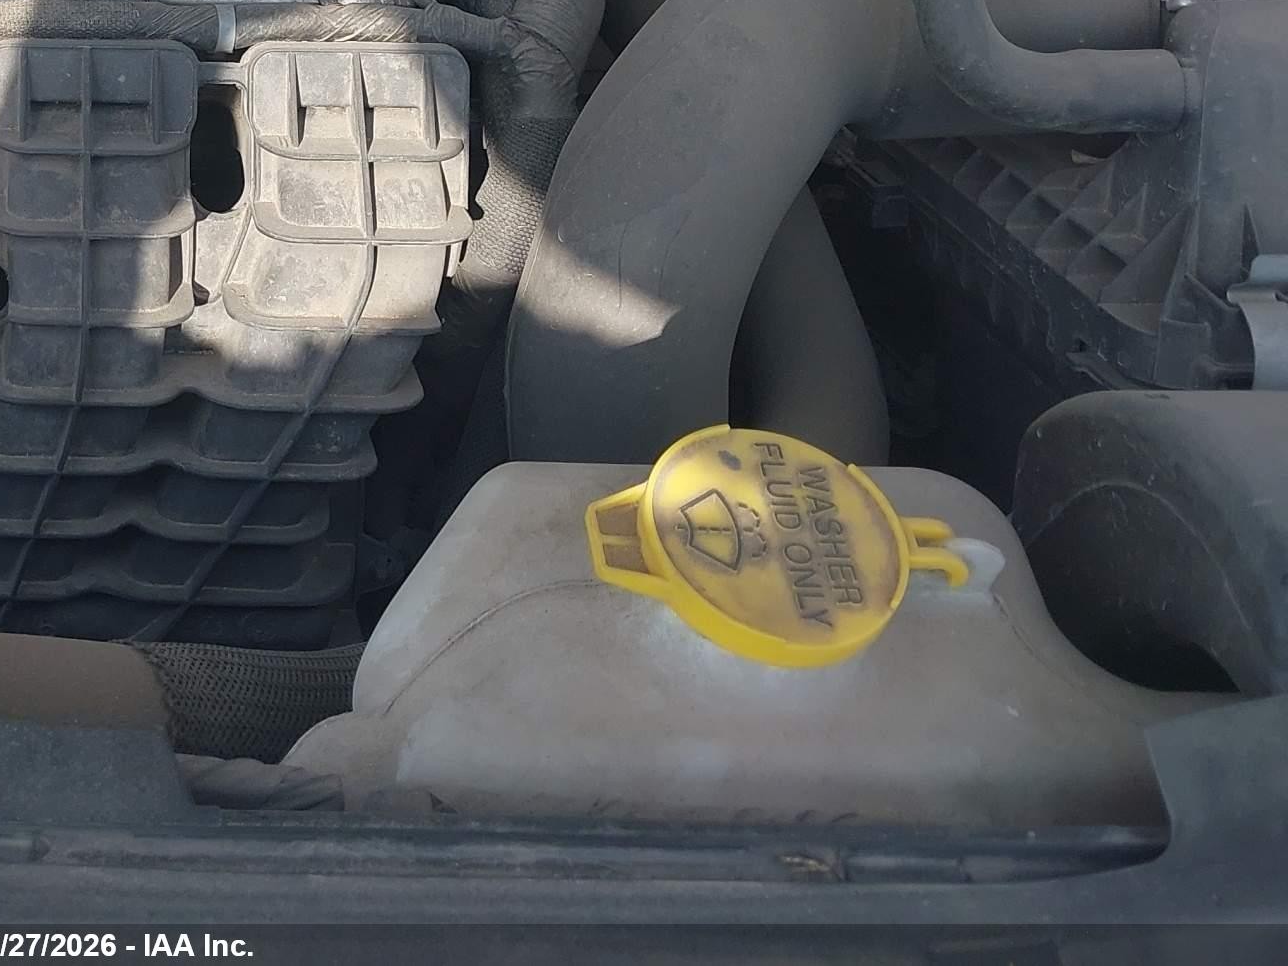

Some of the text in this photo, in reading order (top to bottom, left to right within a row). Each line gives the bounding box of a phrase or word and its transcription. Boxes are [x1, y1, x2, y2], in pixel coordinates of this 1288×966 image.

[753, 441, 833, 629] FLUID ONLY
[799, 465, 864, 607] WASHER
